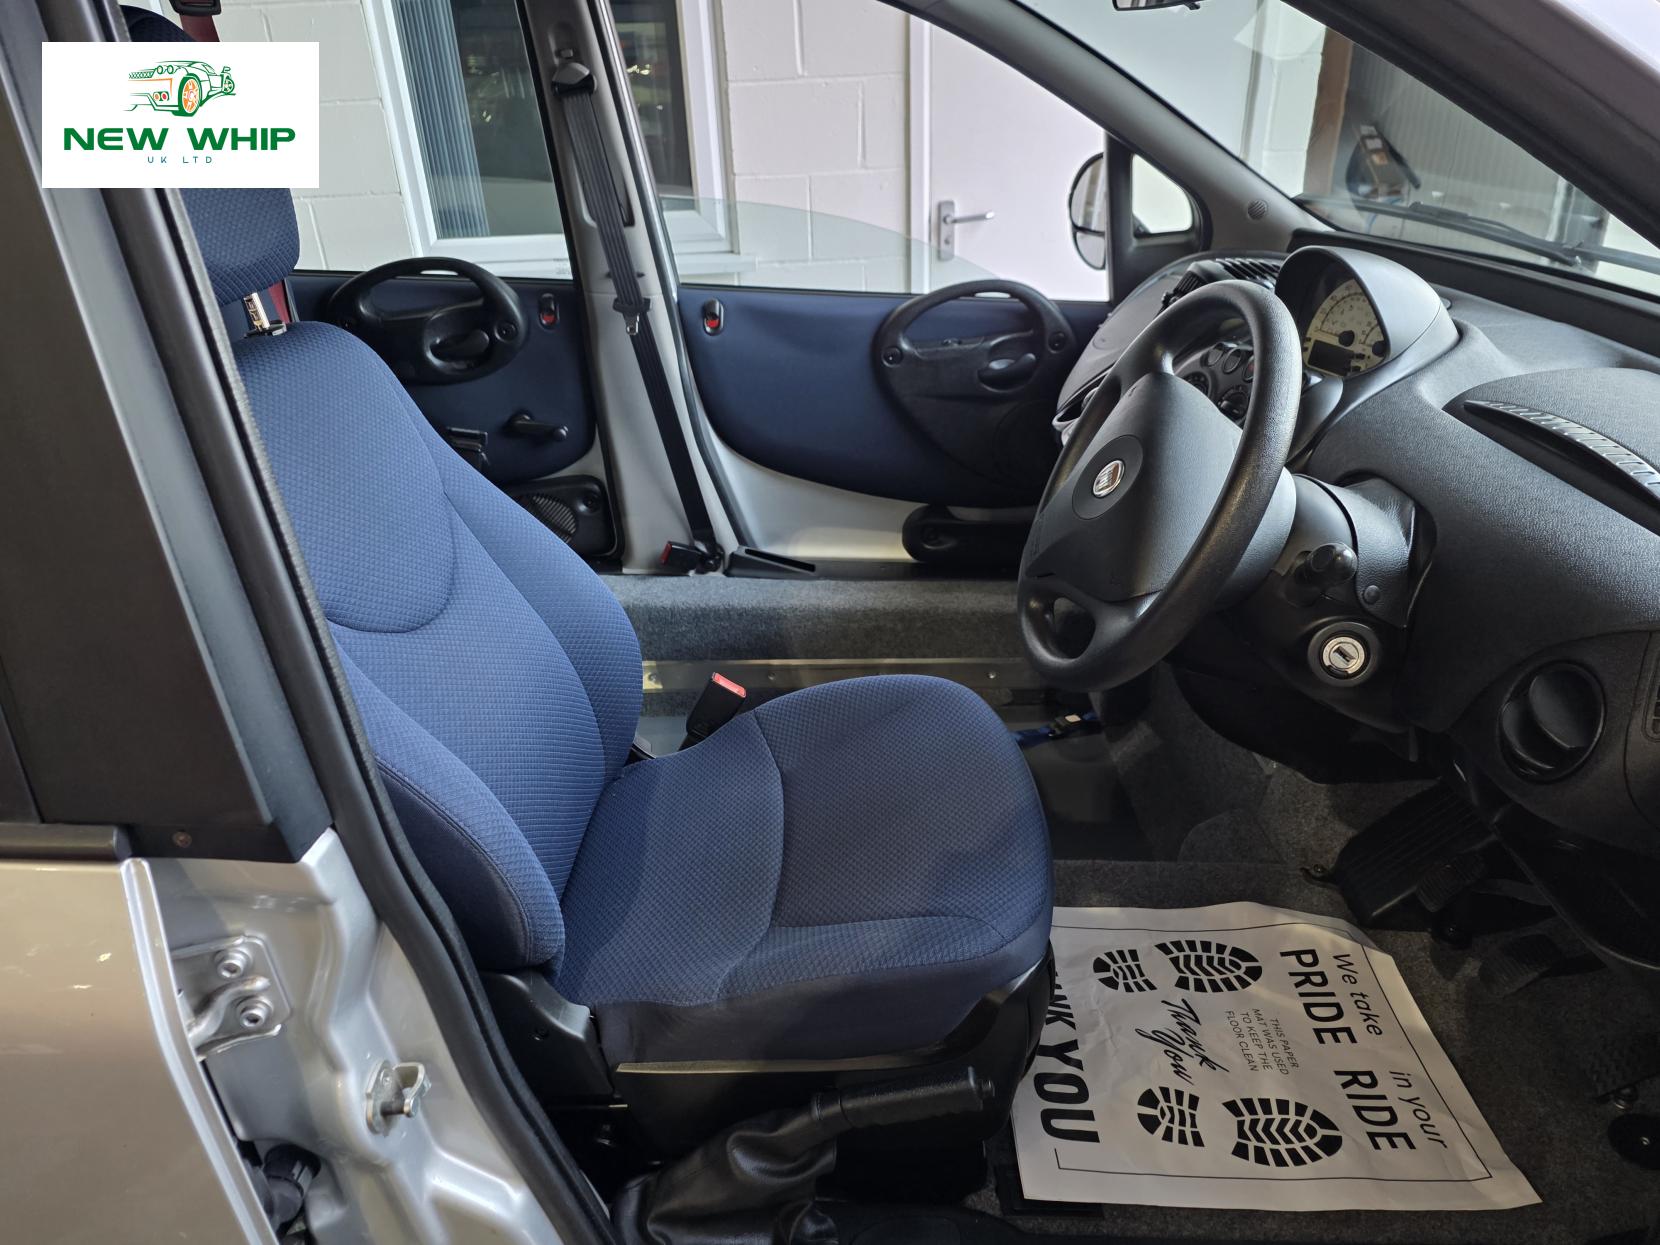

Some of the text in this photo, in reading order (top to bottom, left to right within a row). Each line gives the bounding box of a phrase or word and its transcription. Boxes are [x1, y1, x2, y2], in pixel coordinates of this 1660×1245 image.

[1279, 949, 1358, 1045] PRIDE
[1332, 953, 1383, 1036] We take
[1134, 1027, 1195, 1086] You
[1160, 998, 1230, 1073] Thank
[1224, 1010, 1260, 1072] FLOOR CLEAN
[1240, 1012, 1274, 1071] TO KEEP THE
[1252, 1008, 1289, 1075] MAT WAS USED
[1269, 1018, 1299, 1068] THIS PAPER
[1033, 1038, 1101, 1144] YOU
[1333, 1070, 1417, 1150] RIDE
[1388, 1070, 1448, 1149] in your
